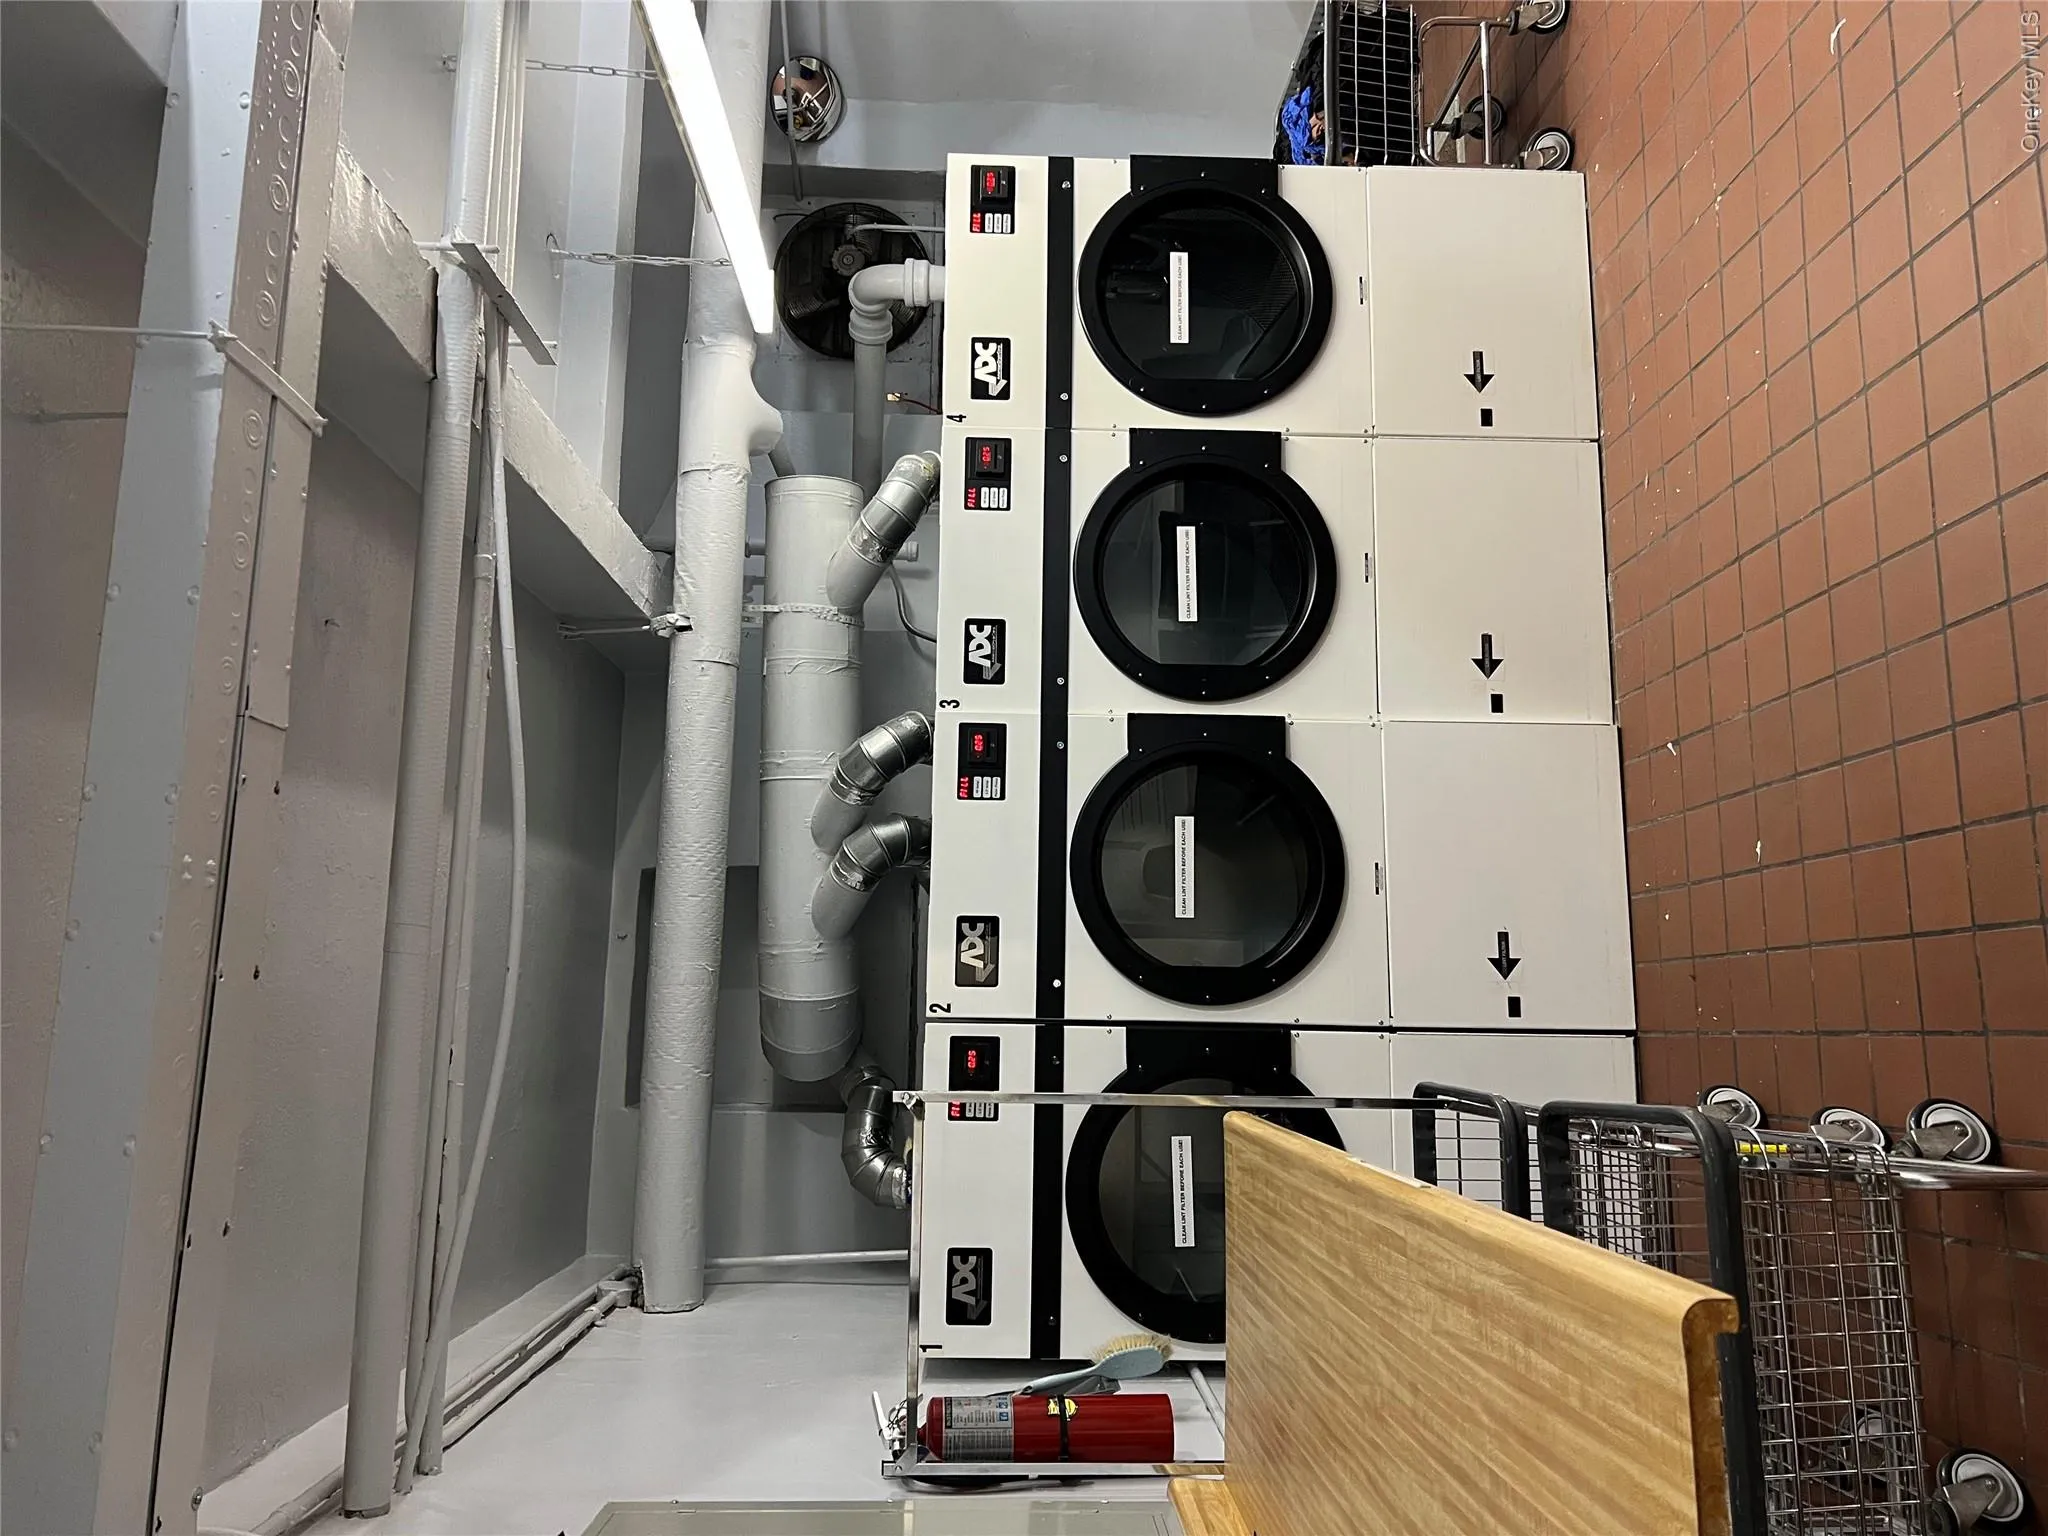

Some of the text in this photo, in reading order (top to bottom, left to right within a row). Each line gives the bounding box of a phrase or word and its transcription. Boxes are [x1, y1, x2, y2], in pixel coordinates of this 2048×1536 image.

[972, 212, 981, 232] FILL
[974, 342, 997, 385] ADC
[946, 414, 967, 423] 4
[967, 487, 976, 508] FILL
[968, 624, 992, 668] ADC
[939, 699, 960, 709] 3
[959, 776, 969, 798] FILL
[960, 922, 985, 969] ADC
[929, 1003, 951, 1014] 2
[951, 1255, 977, 1305] ADC
[919, 1344, 943, 1353] 1
